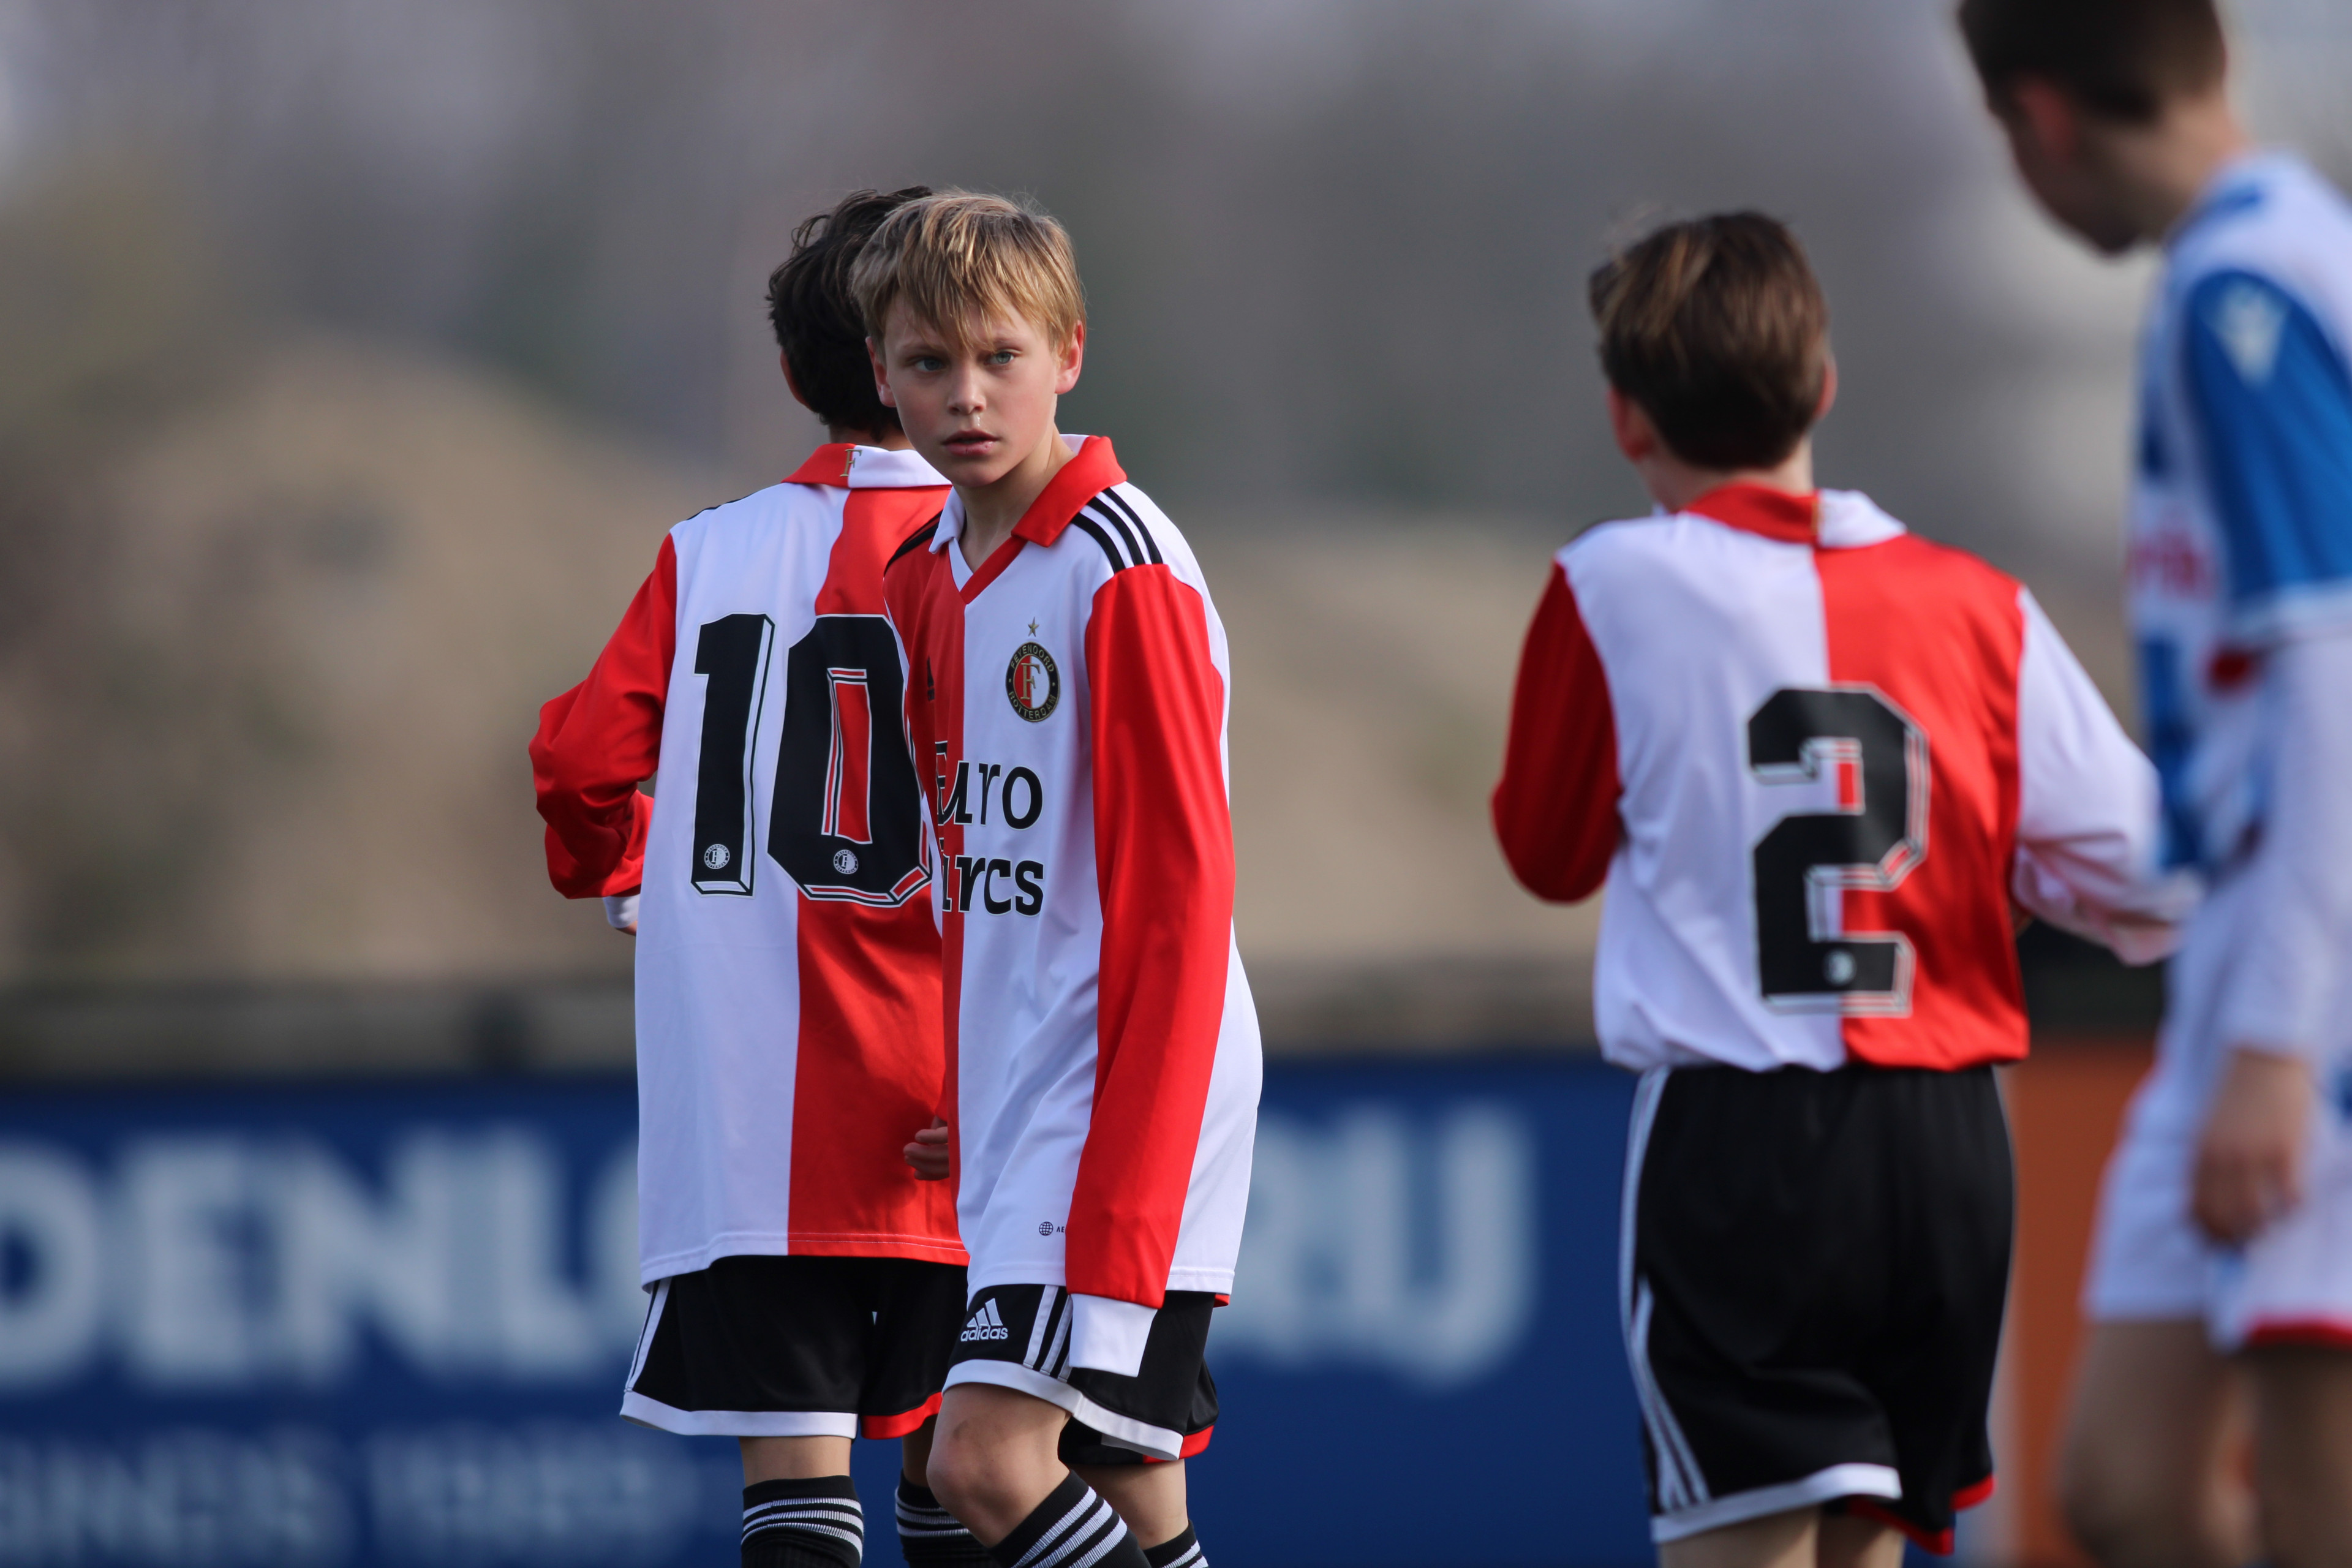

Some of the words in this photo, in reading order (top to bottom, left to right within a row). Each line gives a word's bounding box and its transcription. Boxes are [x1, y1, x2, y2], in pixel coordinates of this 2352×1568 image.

[840, 448, 862, 477] F
[1011, 644, 1054, 672] FEYENOORD
[1020, 662, 1041, 699] F
[1009, 691, 1057, 719] ROTTERDAM
[690, 611, 933, 908] 10
[1746, 681, 1932, 1018] 2
[960, 1325, 1009, 1342] adidas
